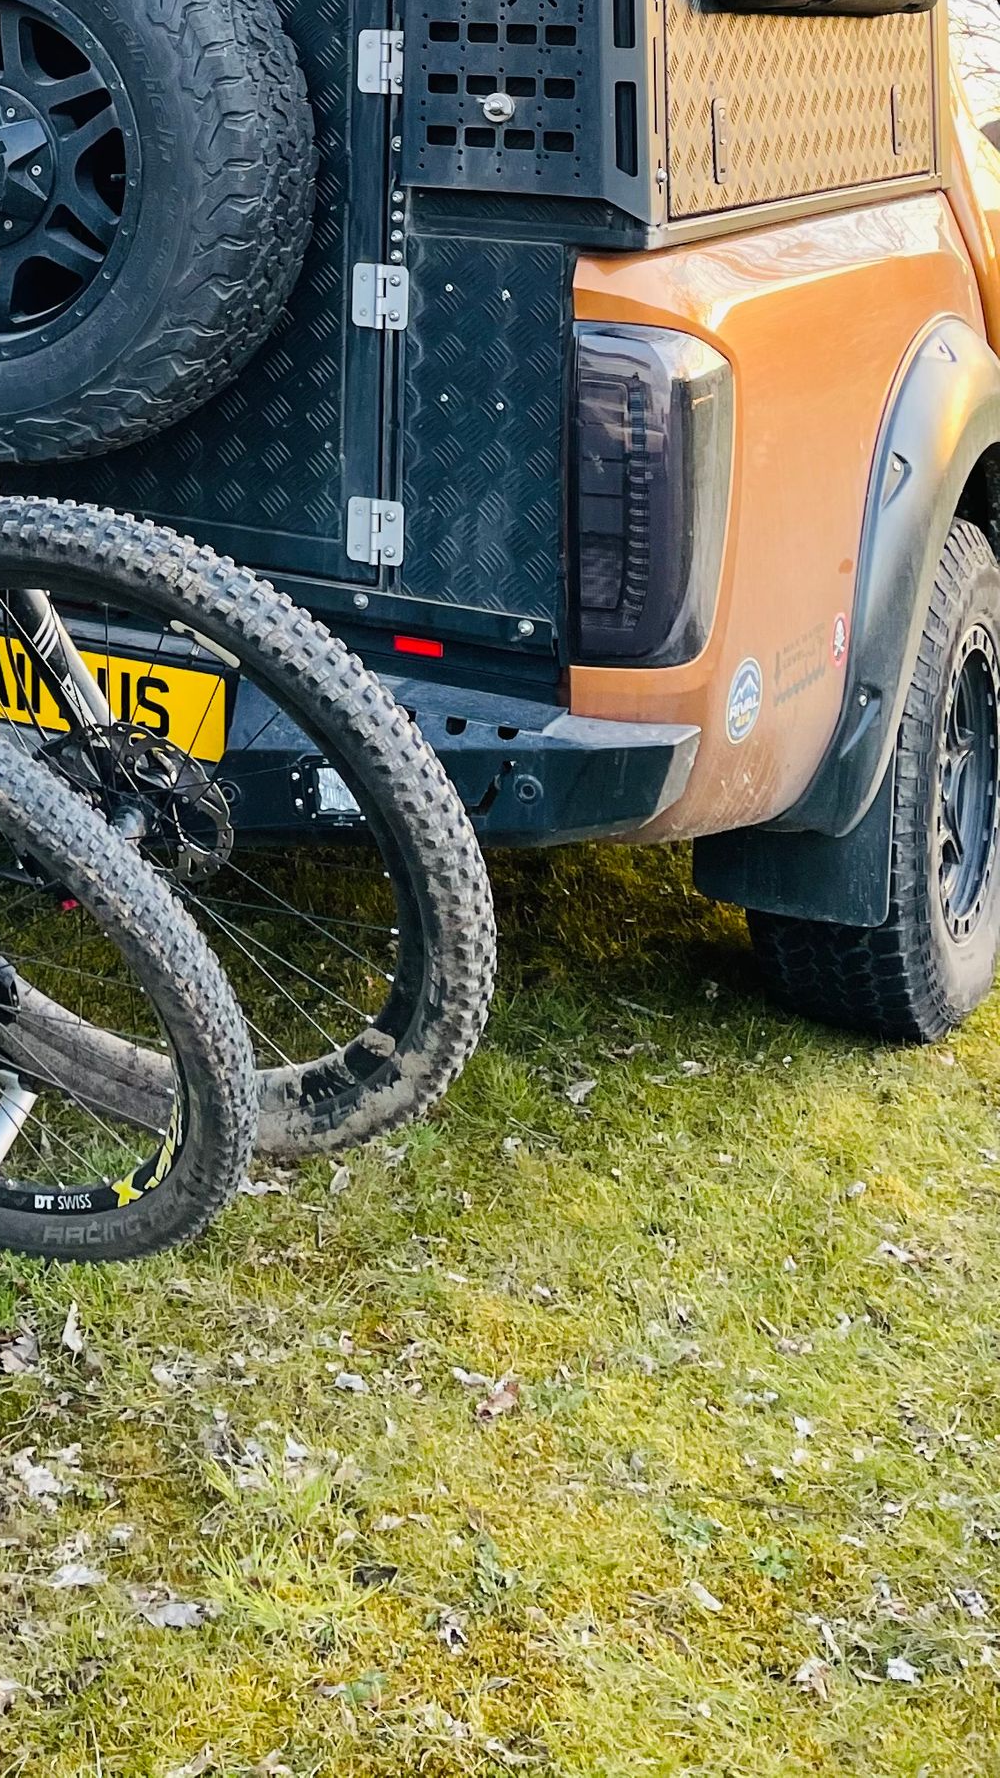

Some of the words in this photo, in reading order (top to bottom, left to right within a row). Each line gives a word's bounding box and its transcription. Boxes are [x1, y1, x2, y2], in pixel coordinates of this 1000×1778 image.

[58, 666, 170, 739] US
[34, 1194, 55, 1210] DT
[57, 1193, 93, 1211] SWISS
